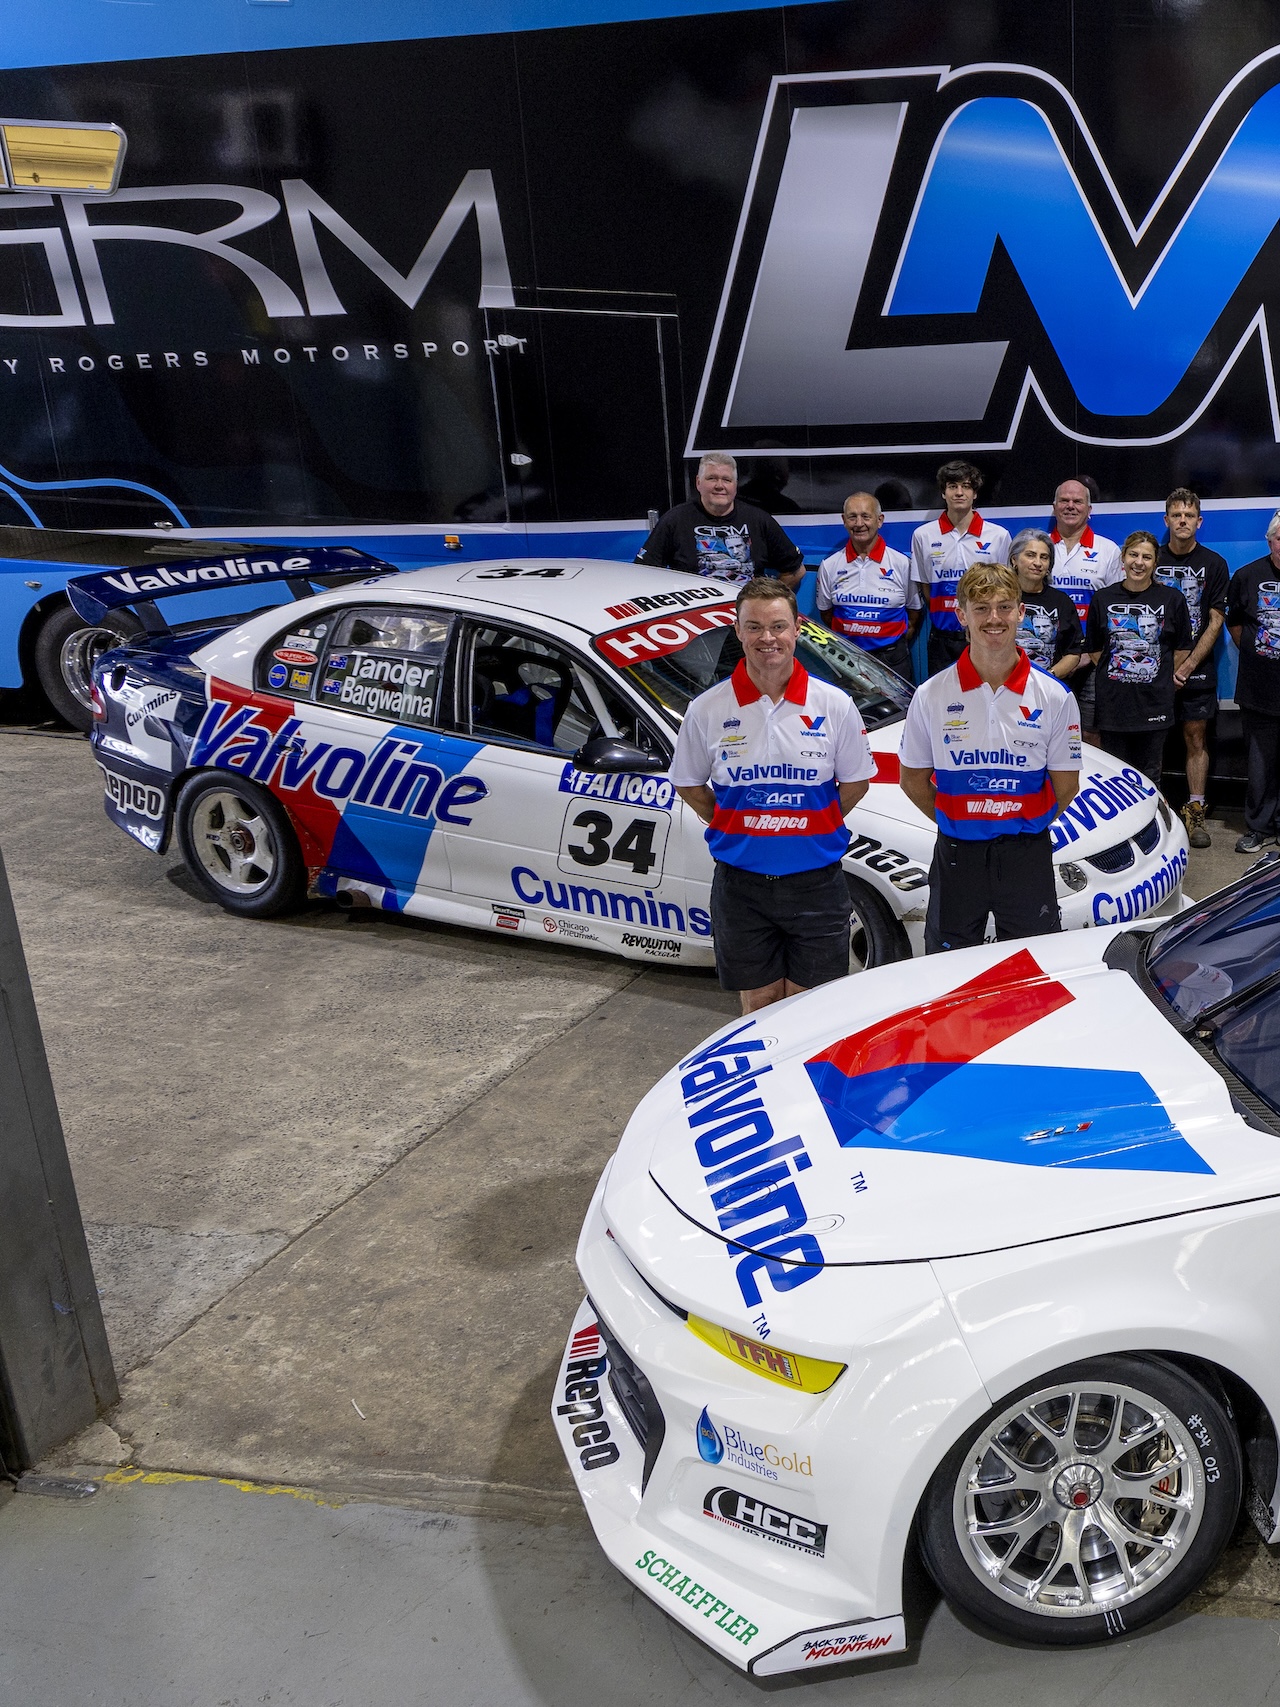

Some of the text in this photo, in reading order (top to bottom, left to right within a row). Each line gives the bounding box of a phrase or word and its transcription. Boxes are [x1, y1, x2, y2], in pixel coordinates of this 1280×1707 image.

[48, 350, 209, 374] ROGERS
[241, 337, 528, 366] MOTORSPORT
[693, 524, 750, 536] GRM
[102, 556, 311, 594] Valvoline
[476, 567, 567, 580] 34
[1053, 576, 1091, 586] lvoline
[1154, 566, 1205, 578] GRM
[636, 586, 725, 613] Repco
[835, 593, 890, 605] Valvoline
[1024, 603, 1059, 617] RM
[1107, 604, 1165, 615] GRM
[850, 623, 881, 634] Repco
[855, 611, 880, 619] AAT
[606, 606, 737, 660] HOLD
[351, 650, 434, 689] Tander
[340, 676, 434, 719] Bargwanna
[800, 730, 826, 738] Valvoline
[1017, 720, 1042, 730] Valvoline
[189, 702, 490, 827] Valvoline
[800, 750, 827, 758] GRM
[727, 763, 818, 782] Valvoline
[618, 774, 672, 807] 1000
[766, 792, 806, 805] AAT
[755, 814, 808, 832] Repco
[568, 810, 656, 875] 34
[1092, 847, 1188, 926] Cummins
[511, 866, 712, 938] Cummins
[557, 919, 590, 933] Chicago
[621, 933, 682, 953] REVOLUTION
[644, 949, 681, 958] RACEGEAR
[679, 1020, 825, 1309] Valvoline
[850, 1171, 867, 1193] TM
[752, 1312, 771, 1340] TM
[729, 1332, 787, 1377] TFH
[784, 1357, 794, 1379] HIRE
[557, 1357, 620, 1471] Repco
[1187, 1413, 1212, 1448] #34
[723, 1425, 813, 1477] BlueGold
[727, 1447, 778, 1481] Industries
[737, 1496, 819, 1547] HCC
[742, 1526, 826, 1559] DISTRIBUTION
[636, 1550, 759, 1646] SCHAEFFLER
[801, 1633, 869, 1652] BACK TO THE
[804, 1633, 893, 1661] MOUNTAIN
